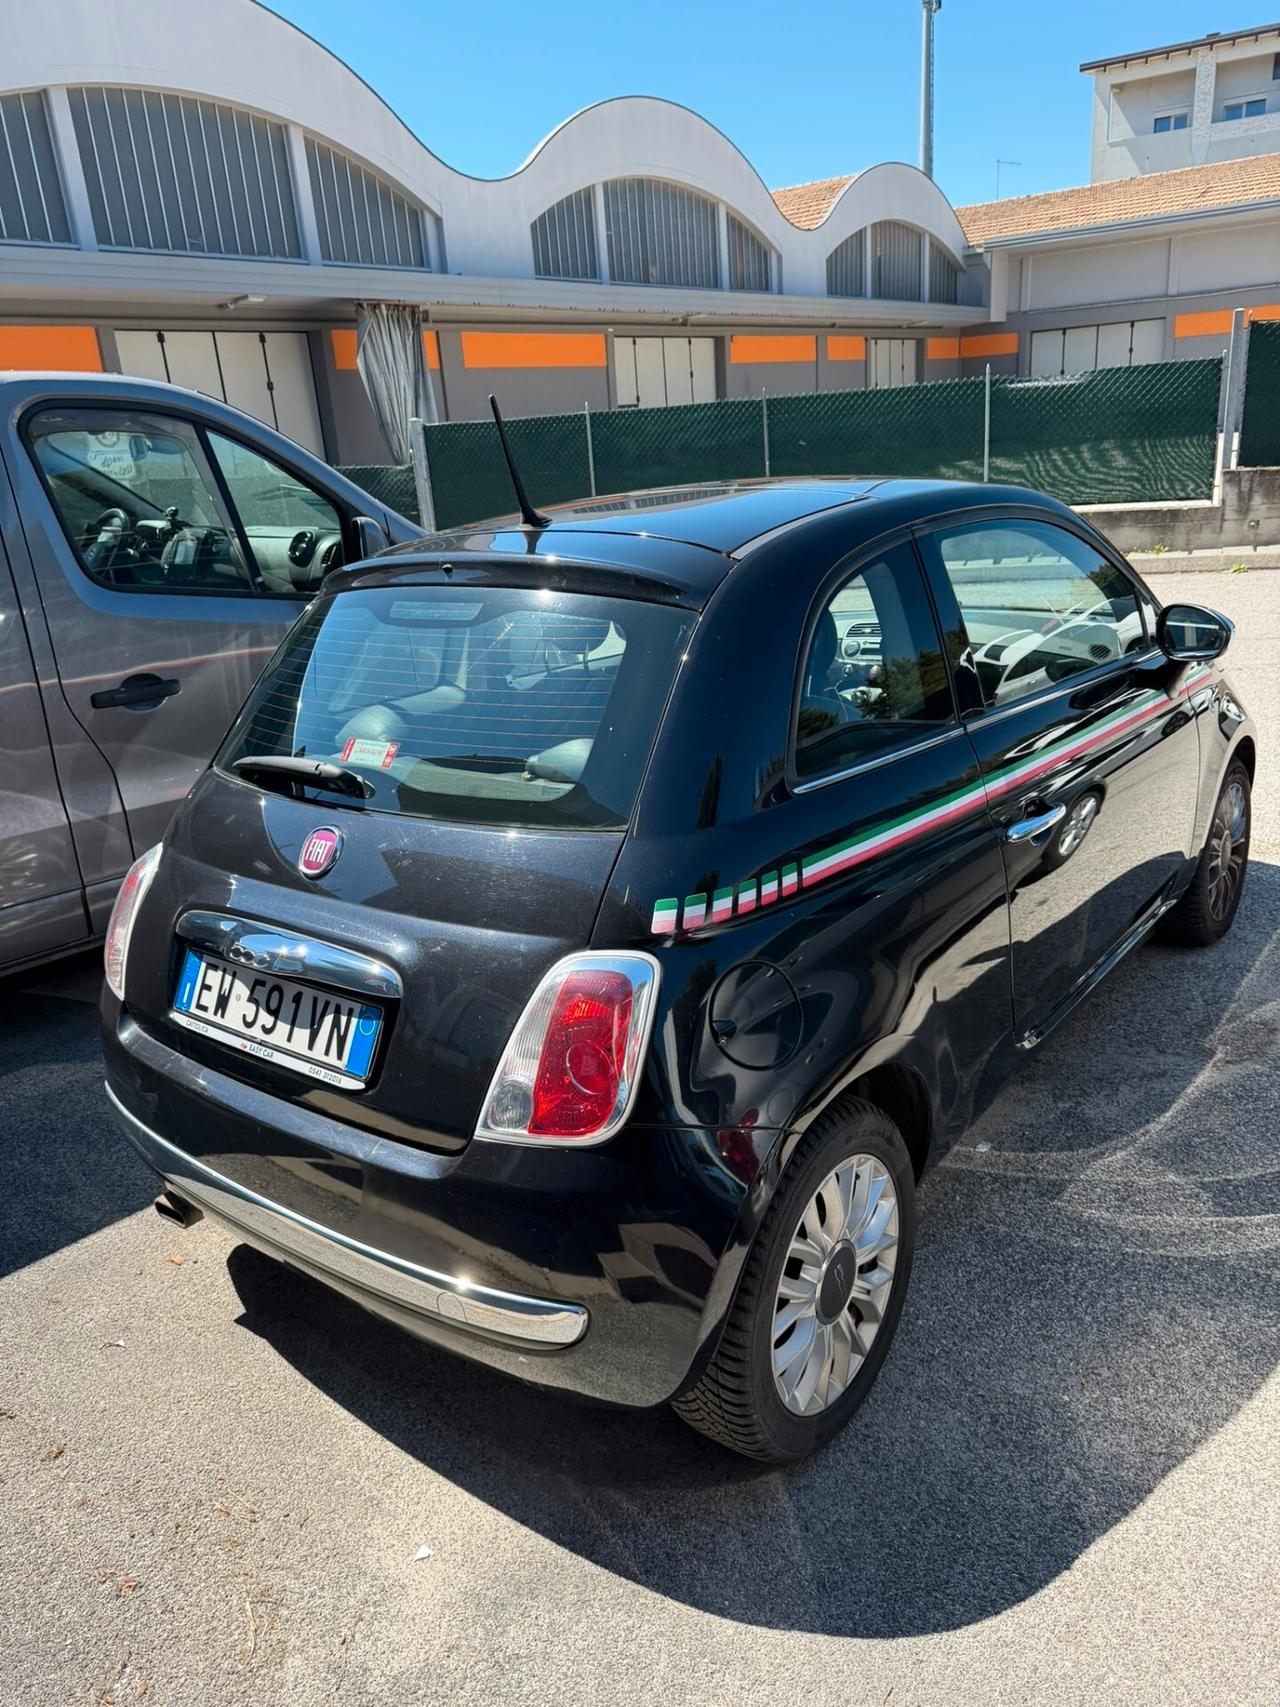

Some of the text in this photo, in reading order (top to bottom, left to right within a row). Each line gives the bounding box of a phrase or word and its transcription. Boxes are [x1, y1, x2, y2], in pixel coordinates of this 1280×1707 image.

[305, 838, 333, 863] FIAT
[195, 962, 354, 1062] EW 591VN
[185, 1019, 209, 1034] CATTOLICA
[249, 1044, 274, 1059] EASY CAR
[308, 1066, 322, 1077] 0541
